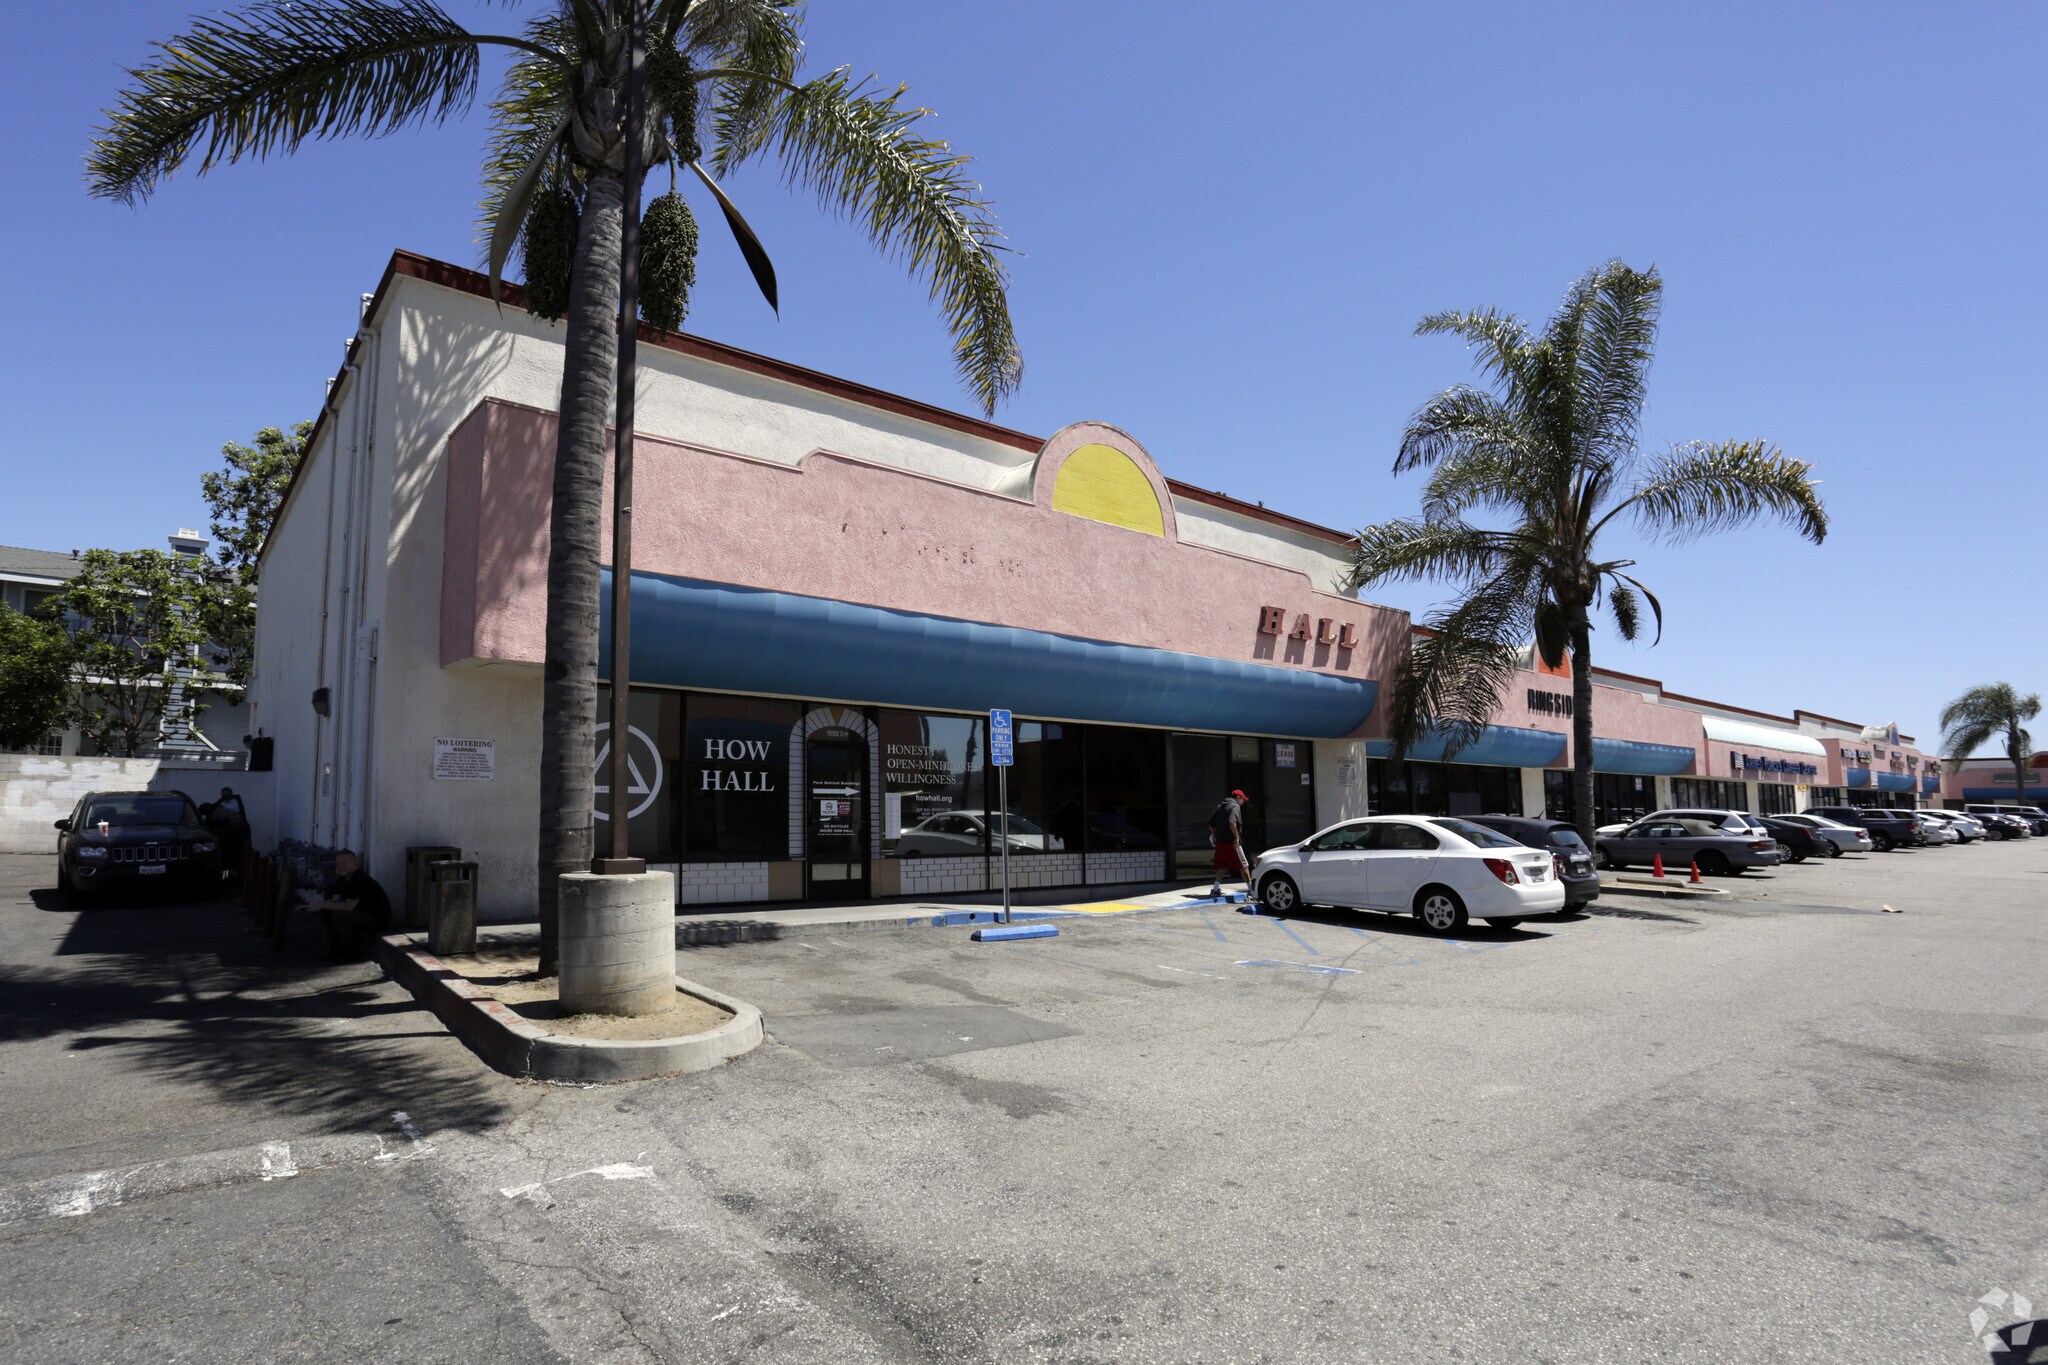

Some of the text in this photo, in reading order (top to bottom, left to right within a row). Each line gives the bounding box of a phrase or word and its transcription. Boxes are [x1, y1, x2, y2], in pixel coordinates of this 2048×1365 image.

[1258, 605, 1359, 649] HALL
[1527, 688, 1573, 716] RINGSID
[992, 727, 1010, 735] PARKING
[450, 740, 493, 748] LOITERING
[704, 738, 772, 761] HOW
[887, 743, 935, 757] HONESTY
[1278, 750, 1294, 758] LEASE
[887, 758, 982, 772] OPEN-MINDEDNESS
[701, 769, 775, 792] HALL
[886, 773, 957, 785] WILLINGNESS
[915, 794, 953, 804] howhall.org
